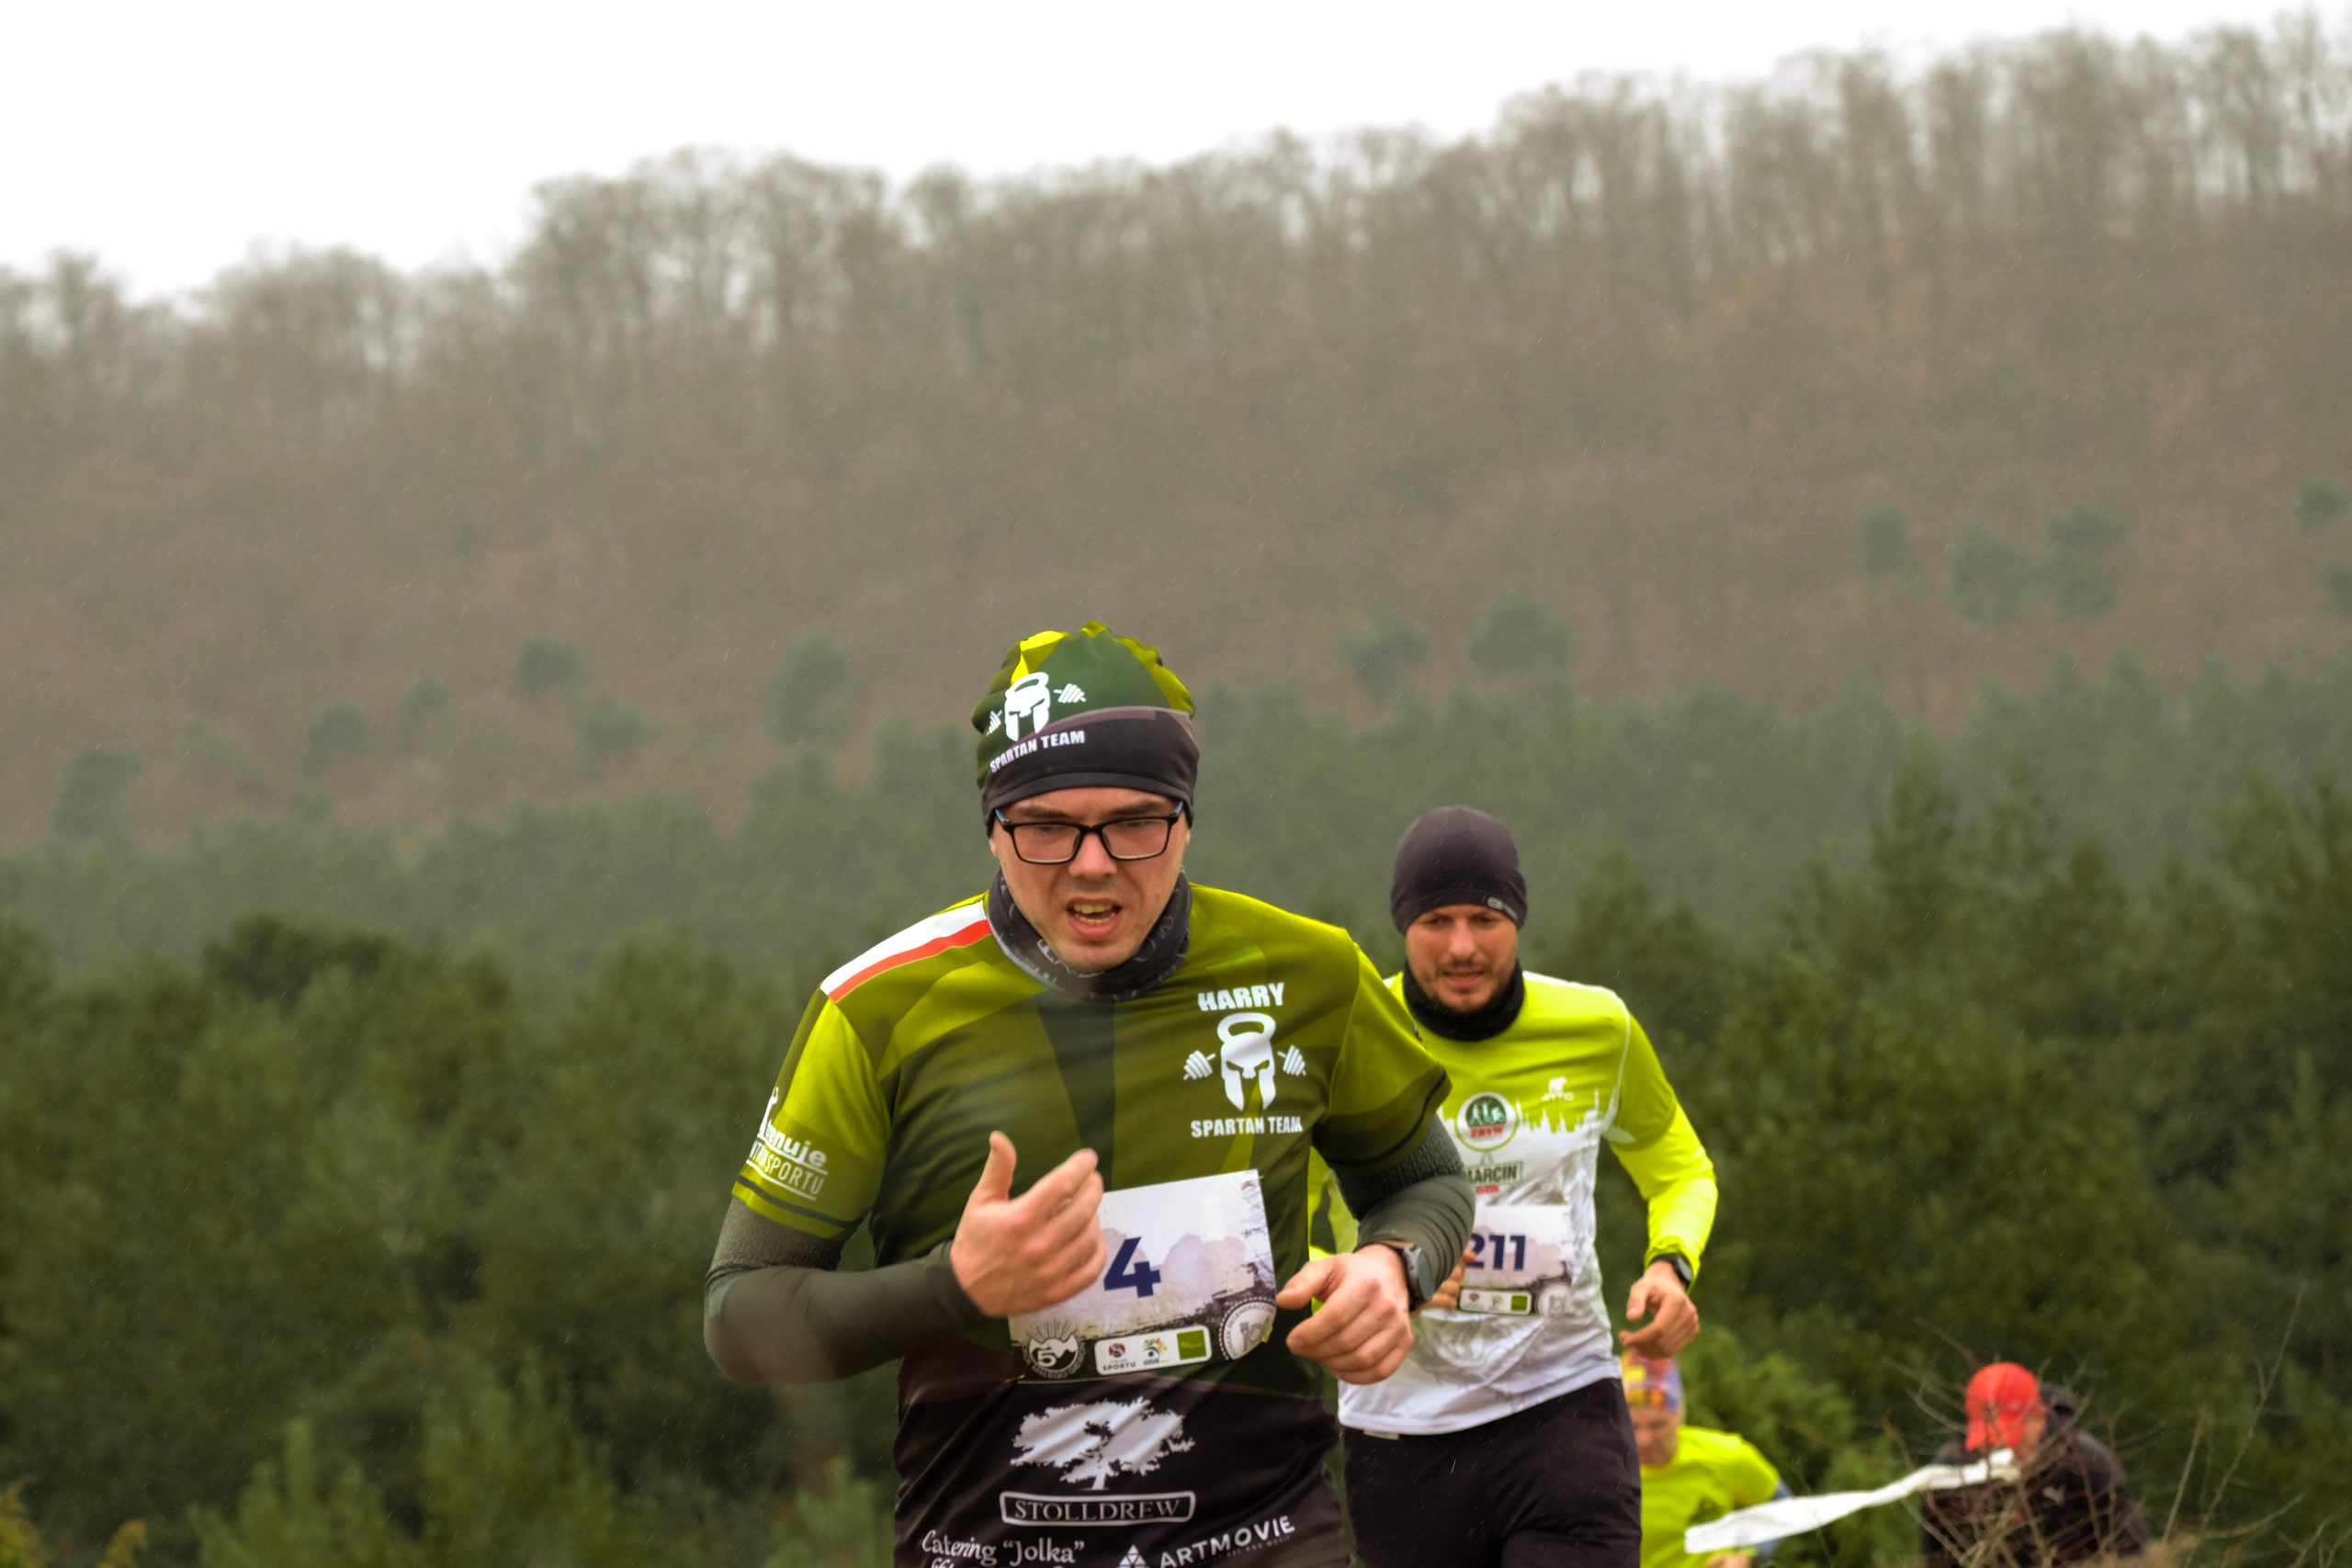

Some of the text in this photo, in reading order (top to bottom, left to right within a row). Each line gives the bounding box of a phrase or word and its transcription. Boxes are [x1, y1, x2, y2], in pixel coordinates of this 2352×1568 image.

[990, 730, 1085, 773] SPARTAN TEAM
[1197, 982, 1284, 1011] HARRY
[1191, 1116, 1303, 1138] SPARTAN TEAM
[1103, 1236, 1161, 1299] 4
[1466, 1234, 1526, 1271] 211
[1037, 1348, 1057, 1368] 5
[1015, 1499, 1181, 1521] STOLLDREW
[922, 1529, 998, 1566] Catering
[1159, 1515, 1295, 1568] ARTMOVIE
